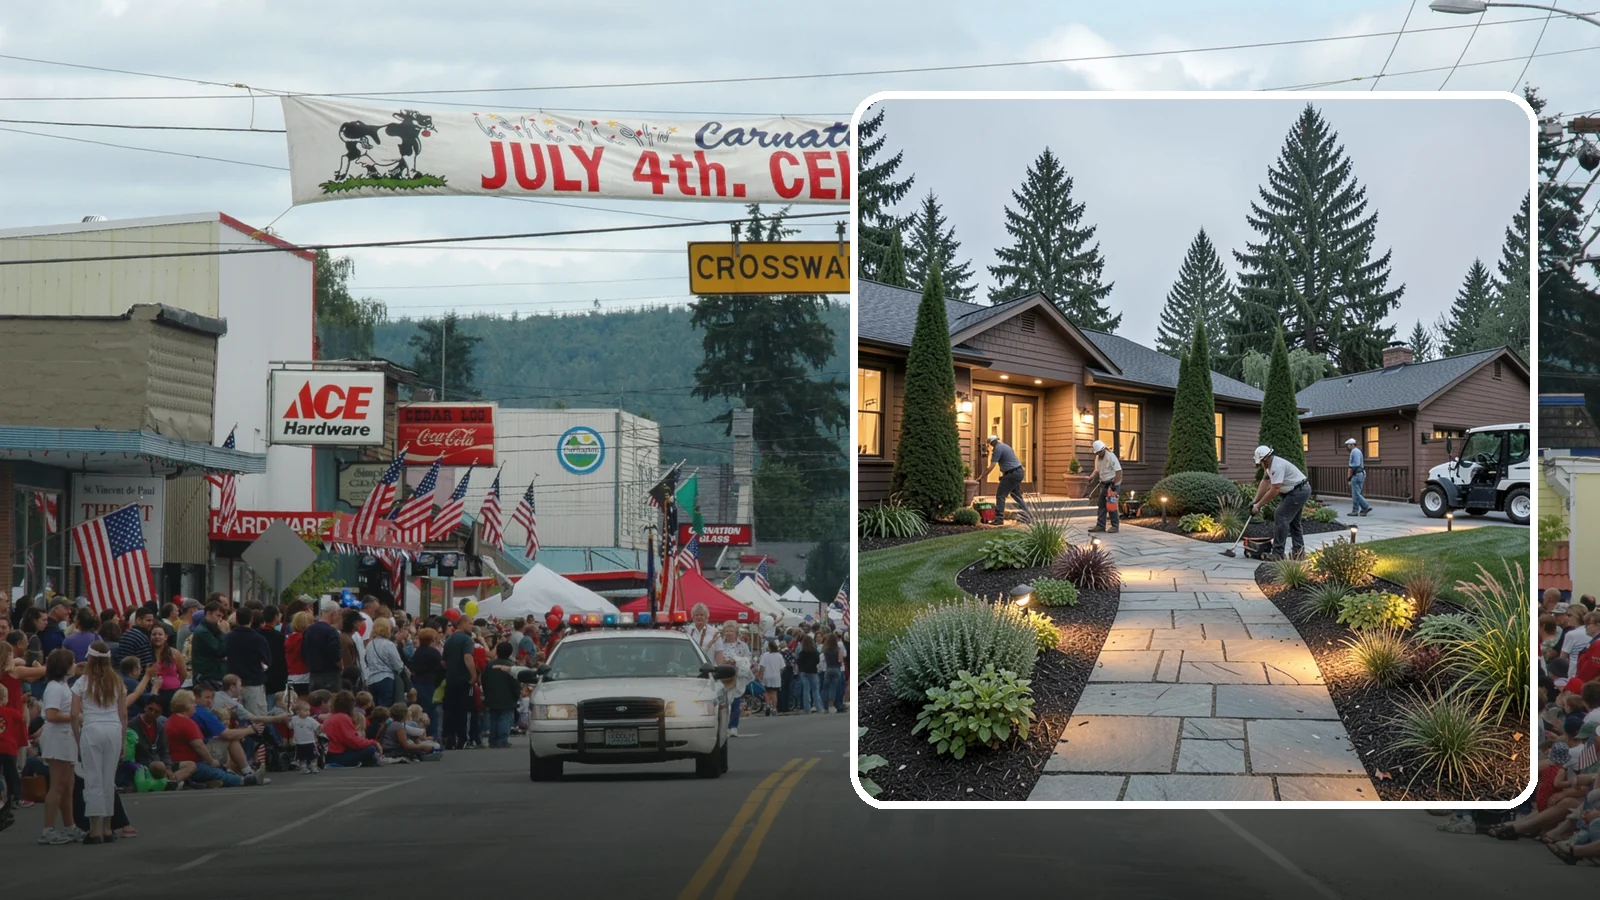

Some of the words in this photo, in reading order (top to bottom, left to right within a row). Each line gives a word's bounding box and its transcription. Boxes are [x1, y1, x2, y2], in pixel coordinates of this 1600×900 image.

[481, 141, 605, 192] JULY
[632, 150, 746, 197] 4th.
[697, 254, 850, 280] CROSSWA
[282, 380, 374, 420] ACE
[405, 409, 453, 421] CEDAR
[283, 421, 371, 436] Hardware
[416, 428, 477, 447] Coca-Cola
[353, 467, 384, 481] Simpl
[95, 485, 124, 494] Vincent
[126, 486, 136, 494] de
[137, 486, 155, 495] Paul
[213, 516, 330, 535] HARDARE
[688, 526, 741, 535] CRNATION
[699, 535, 730, 543] GLASS
